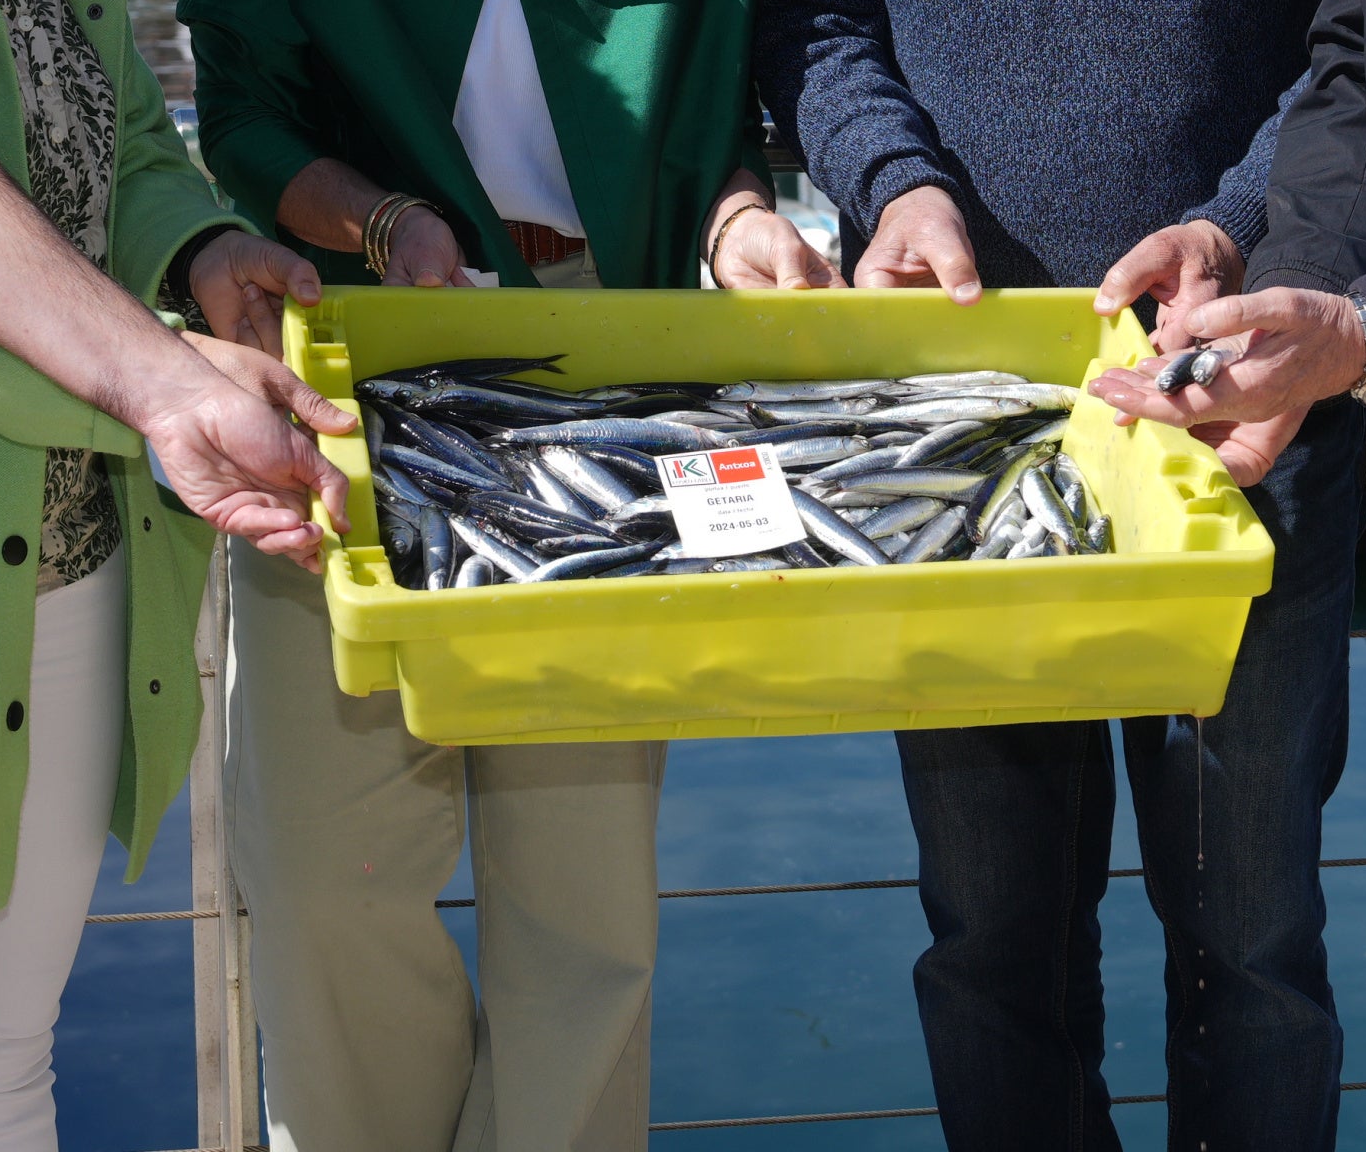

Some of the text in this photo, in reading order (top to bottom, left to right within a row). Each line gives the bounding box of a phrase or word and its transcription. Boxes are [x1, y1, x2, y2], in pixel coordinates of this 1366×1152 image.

[719, 461, 756, 471] Antxoa
[707, 494, 754, 506] GETARIA
[709, 517, 769, 532] 2024-05-03
